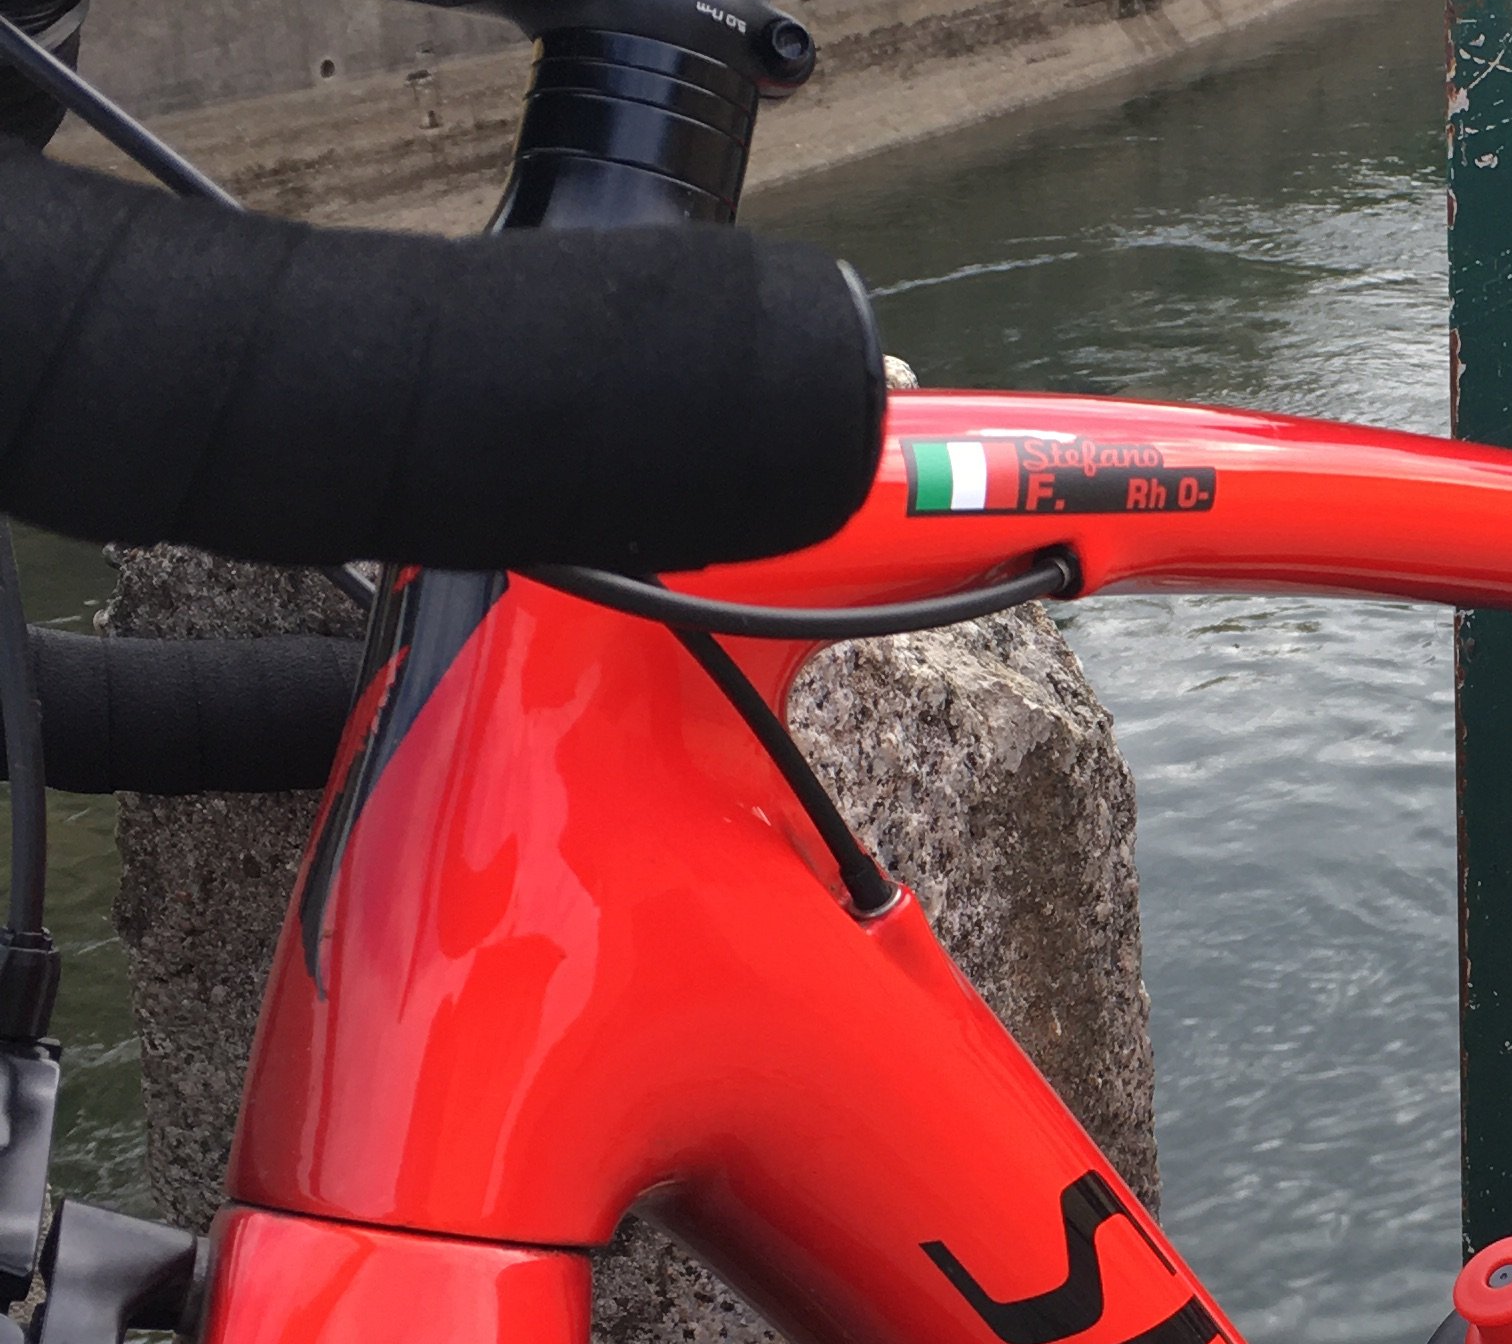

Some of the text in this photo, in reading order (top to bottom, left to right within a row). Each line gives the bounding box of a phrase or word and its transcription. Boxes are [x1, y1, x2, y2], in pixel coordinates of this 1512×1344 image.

[1022, 440, 1159, 477] Stefano
[1025, 473, 1066, 511] F.
[1126, 477, 1167, 510] Rh
